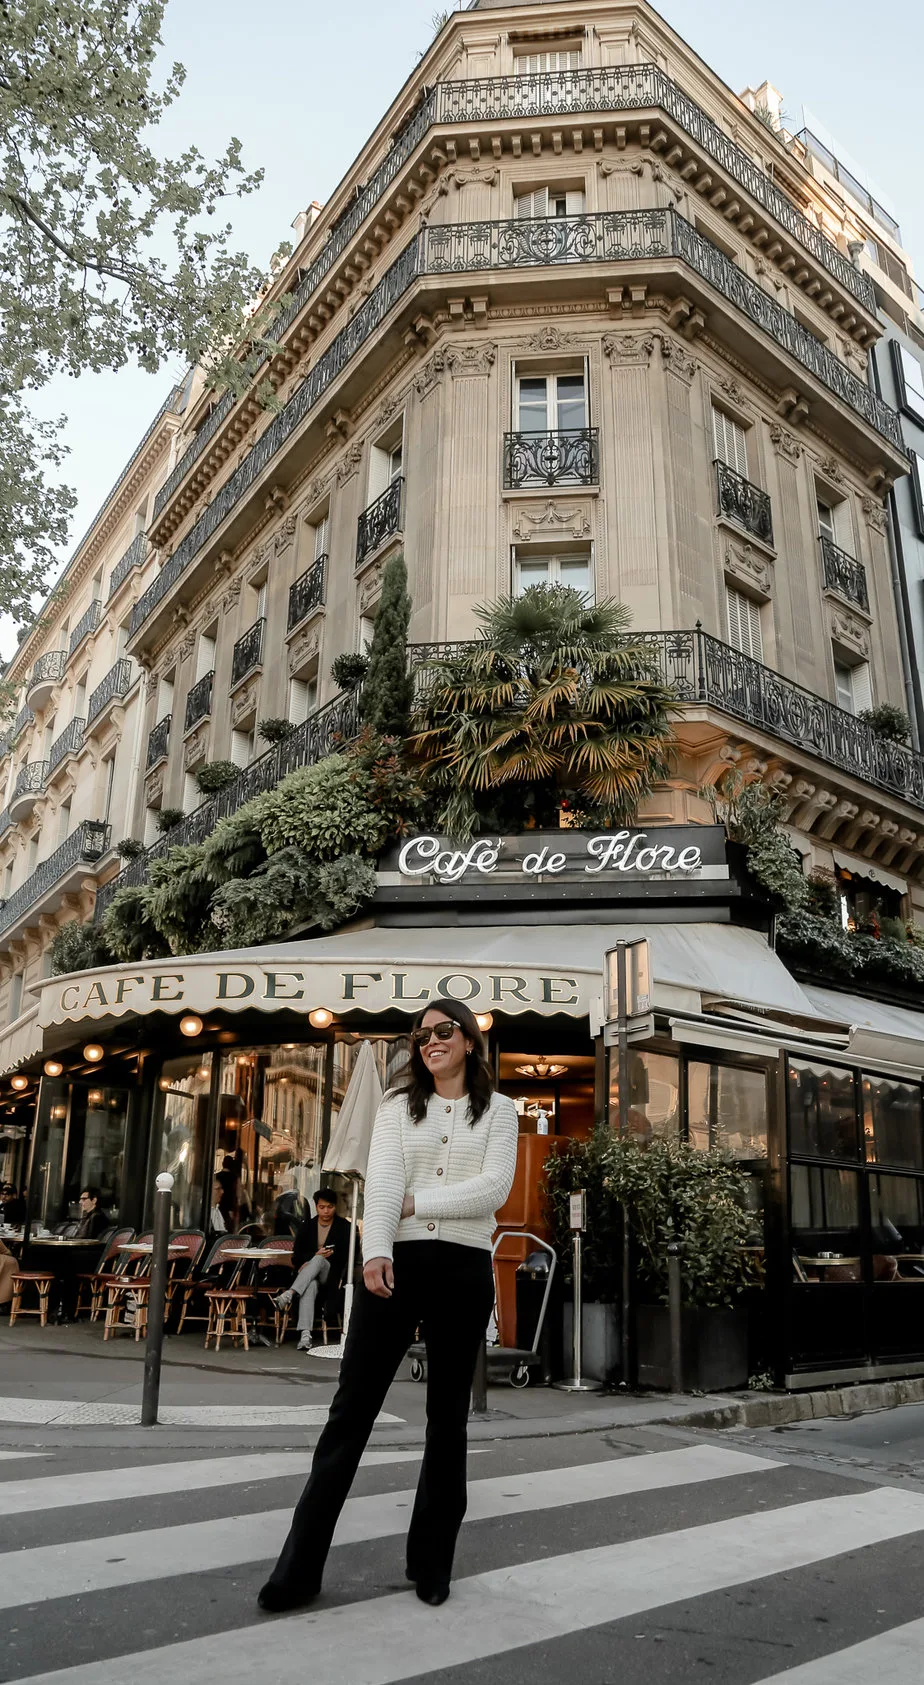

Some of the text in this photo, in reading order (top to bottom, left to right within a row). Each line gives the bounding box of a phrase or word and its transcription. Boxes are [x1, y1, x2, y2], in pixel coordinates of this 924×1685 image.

[398, 830, 702, 883] Café de Flore
[60, 972, 580, 1012] CAFE DE FLORE
